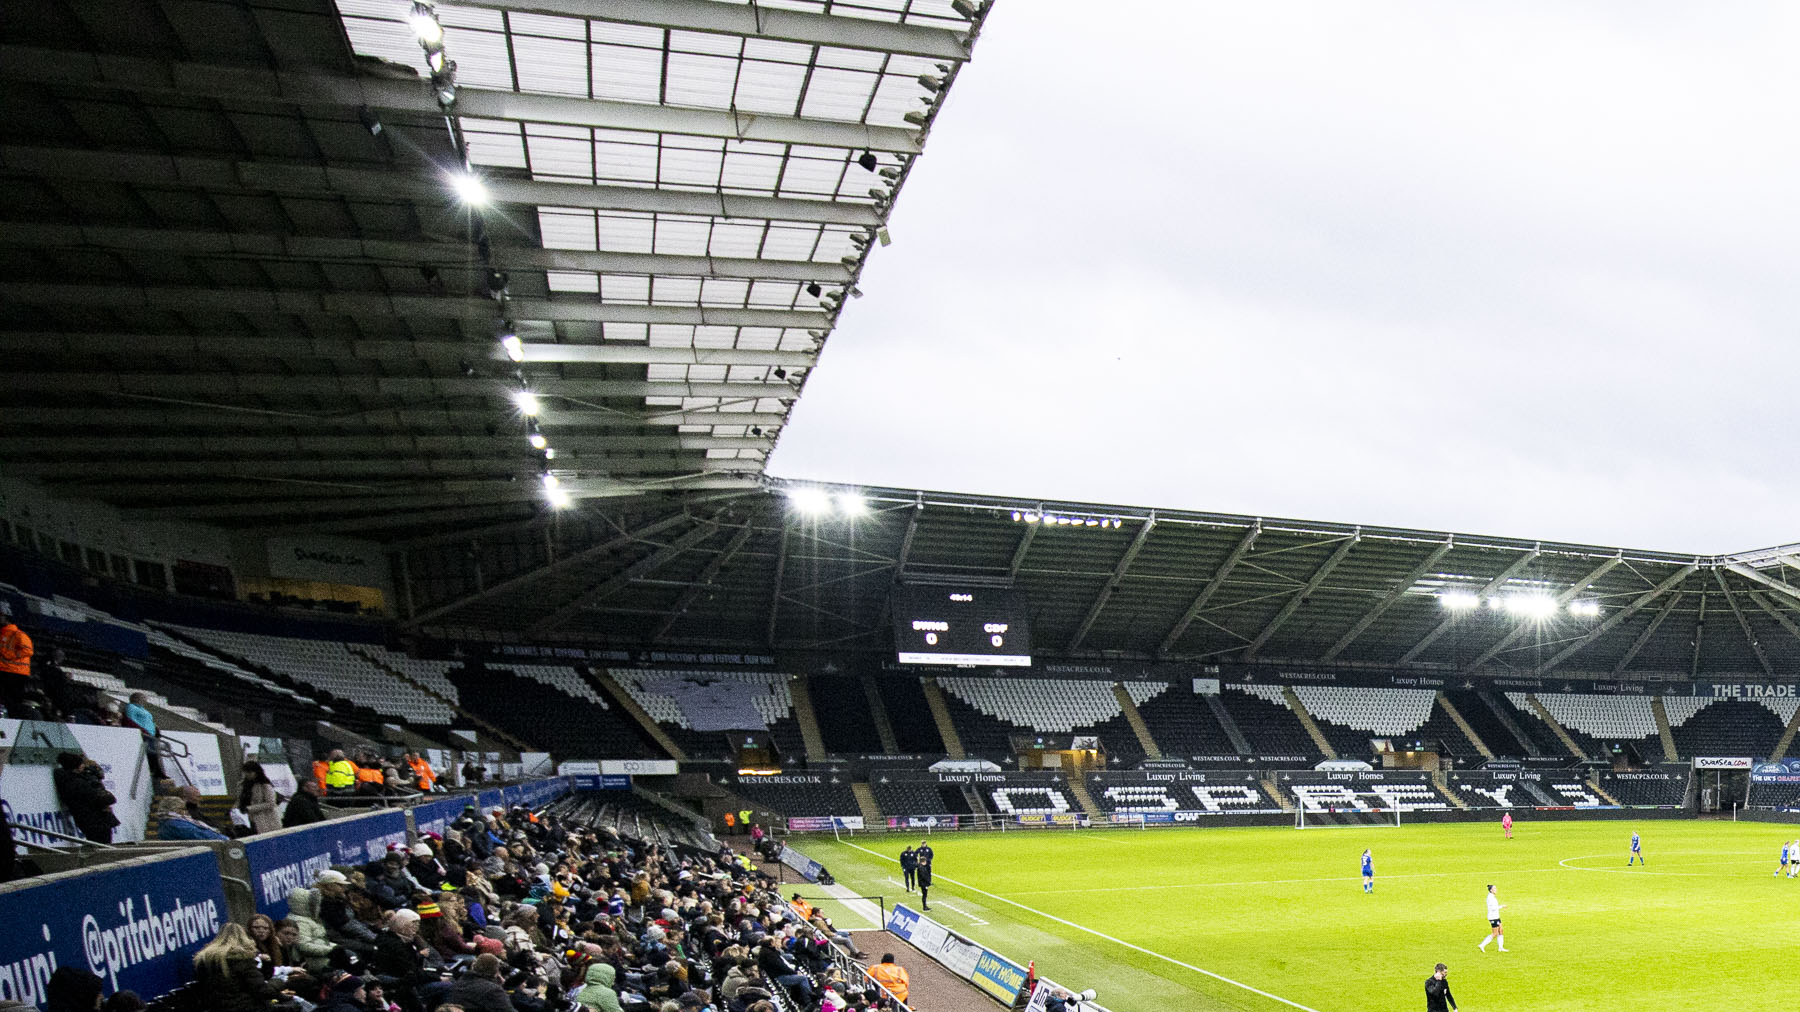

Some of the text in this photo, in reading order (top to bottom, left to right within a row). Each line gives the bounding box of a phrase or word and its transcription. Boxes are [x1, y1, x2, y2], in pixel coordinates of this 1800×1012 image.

[925, 632, 1003, 647] 0 0
[1419, 677, 1444, 686] Homes
[1593, 682, 1644, 694] Luxury Living
[1712, 684, 1741, 697] THE
[1745, 684, 1796, 697] TRADE
[738, 775, 821, 784] WESTACRES.CO.UK
[939, 773, 1006, 784] Luxury Homes
[1146, 771, 1206, 783] Luxury Living
[1327, 771, 1384, 782] Luxury Homes
[1493, 771, 1541, 782] Luxury Living
[82, 894, 220, 992] @prifabertawe
